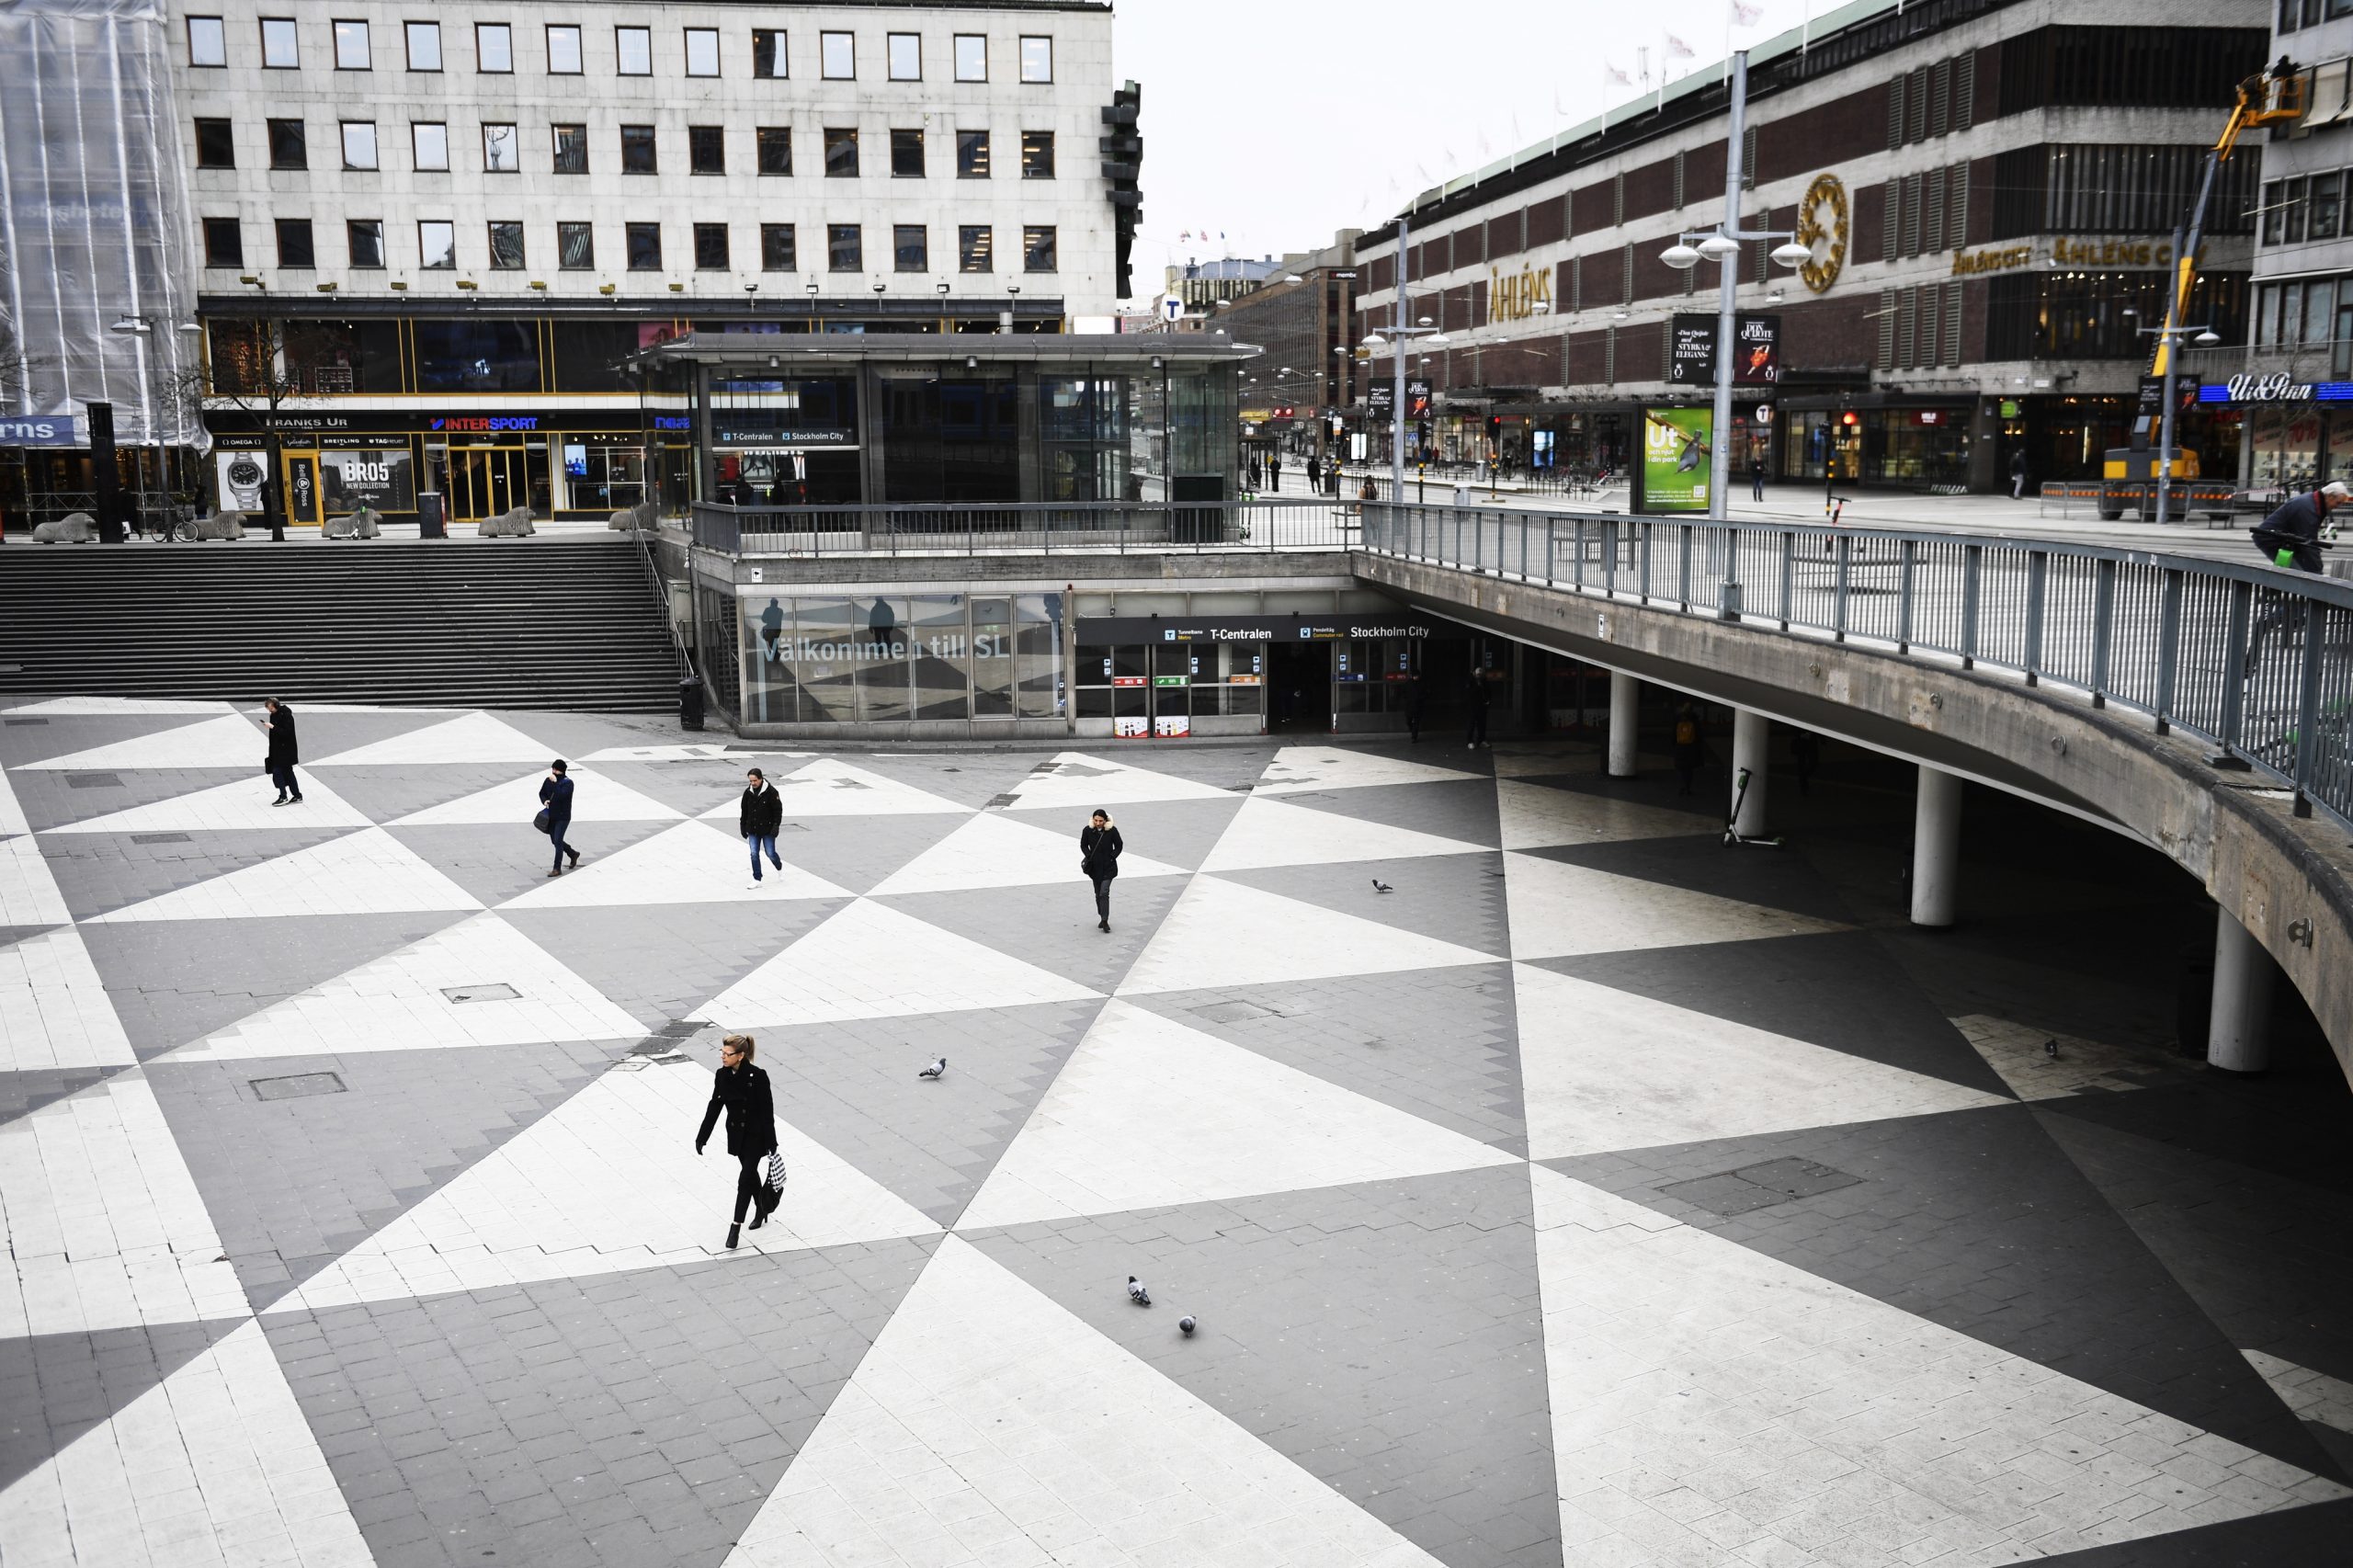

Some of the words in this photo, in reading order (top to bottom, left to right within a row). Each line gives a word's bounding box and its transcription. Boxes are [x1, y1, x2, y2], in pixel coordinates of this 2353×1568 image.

[1489, 262, 1551, 324] ÅHLÉNS
[445, 417, 538, 430] INTERSPORT
[830, 433, 844, 441] City
[1648, 425, 1678, 449] Ut
[1211, 629, 1272, 640] T-Centralen
[1350, 627, 1406, 638] Stockholm
[1408, 626, 1429, 639] City
[763, 636, 922, 662] Välkommen
[929, 634, 965, 660] till
[974, 633, 1010, 660] SL
